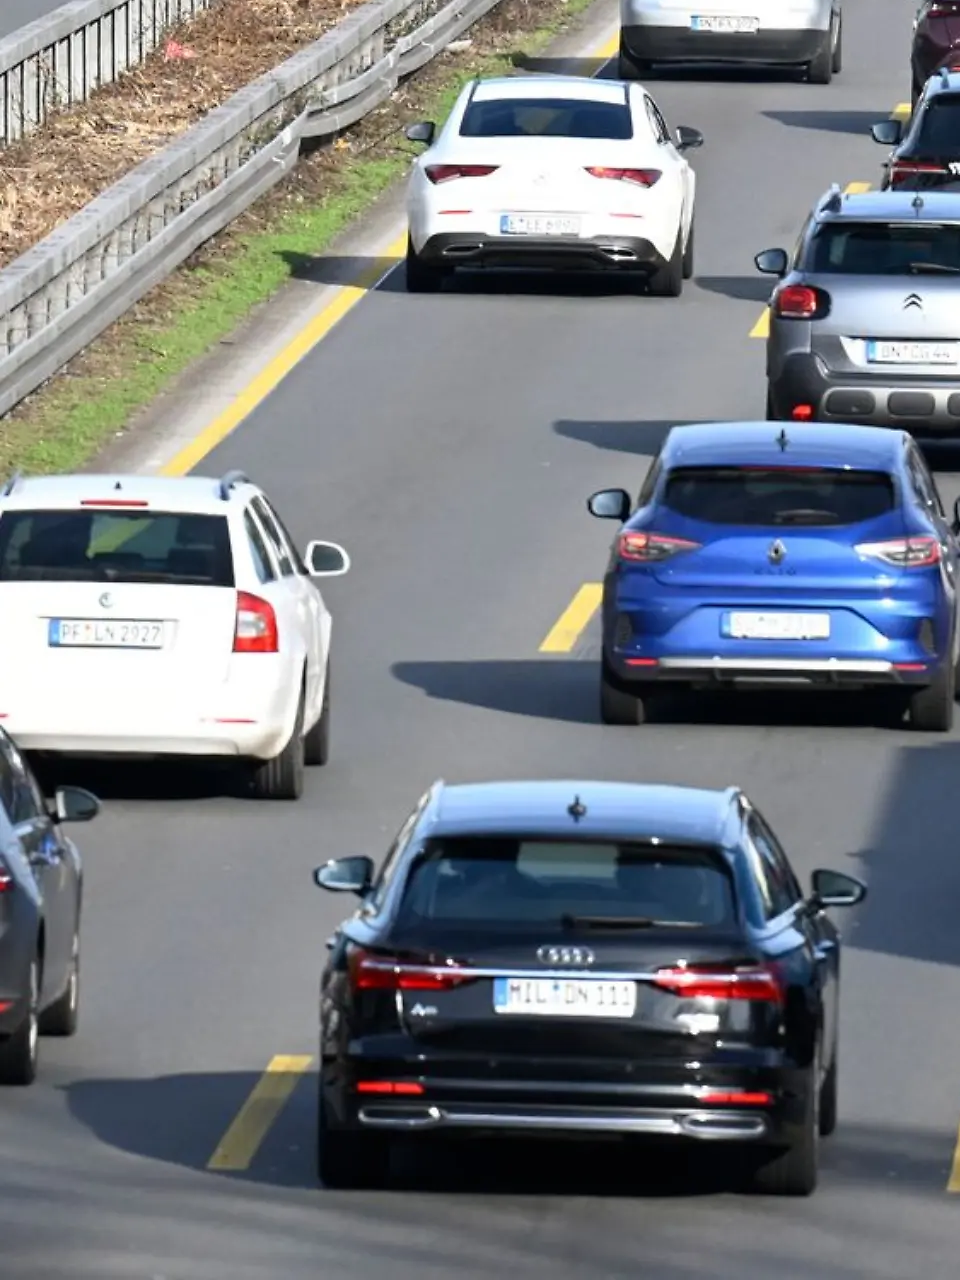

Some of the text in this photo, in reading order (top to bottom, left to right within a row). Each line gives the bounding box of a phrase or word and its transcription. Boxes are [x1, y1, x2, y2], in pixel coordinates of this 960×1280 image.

[61, 622, 81, 641] PF
[508, 982, 548, 1005] MIL
[596, 985, 632, 1008] 111
